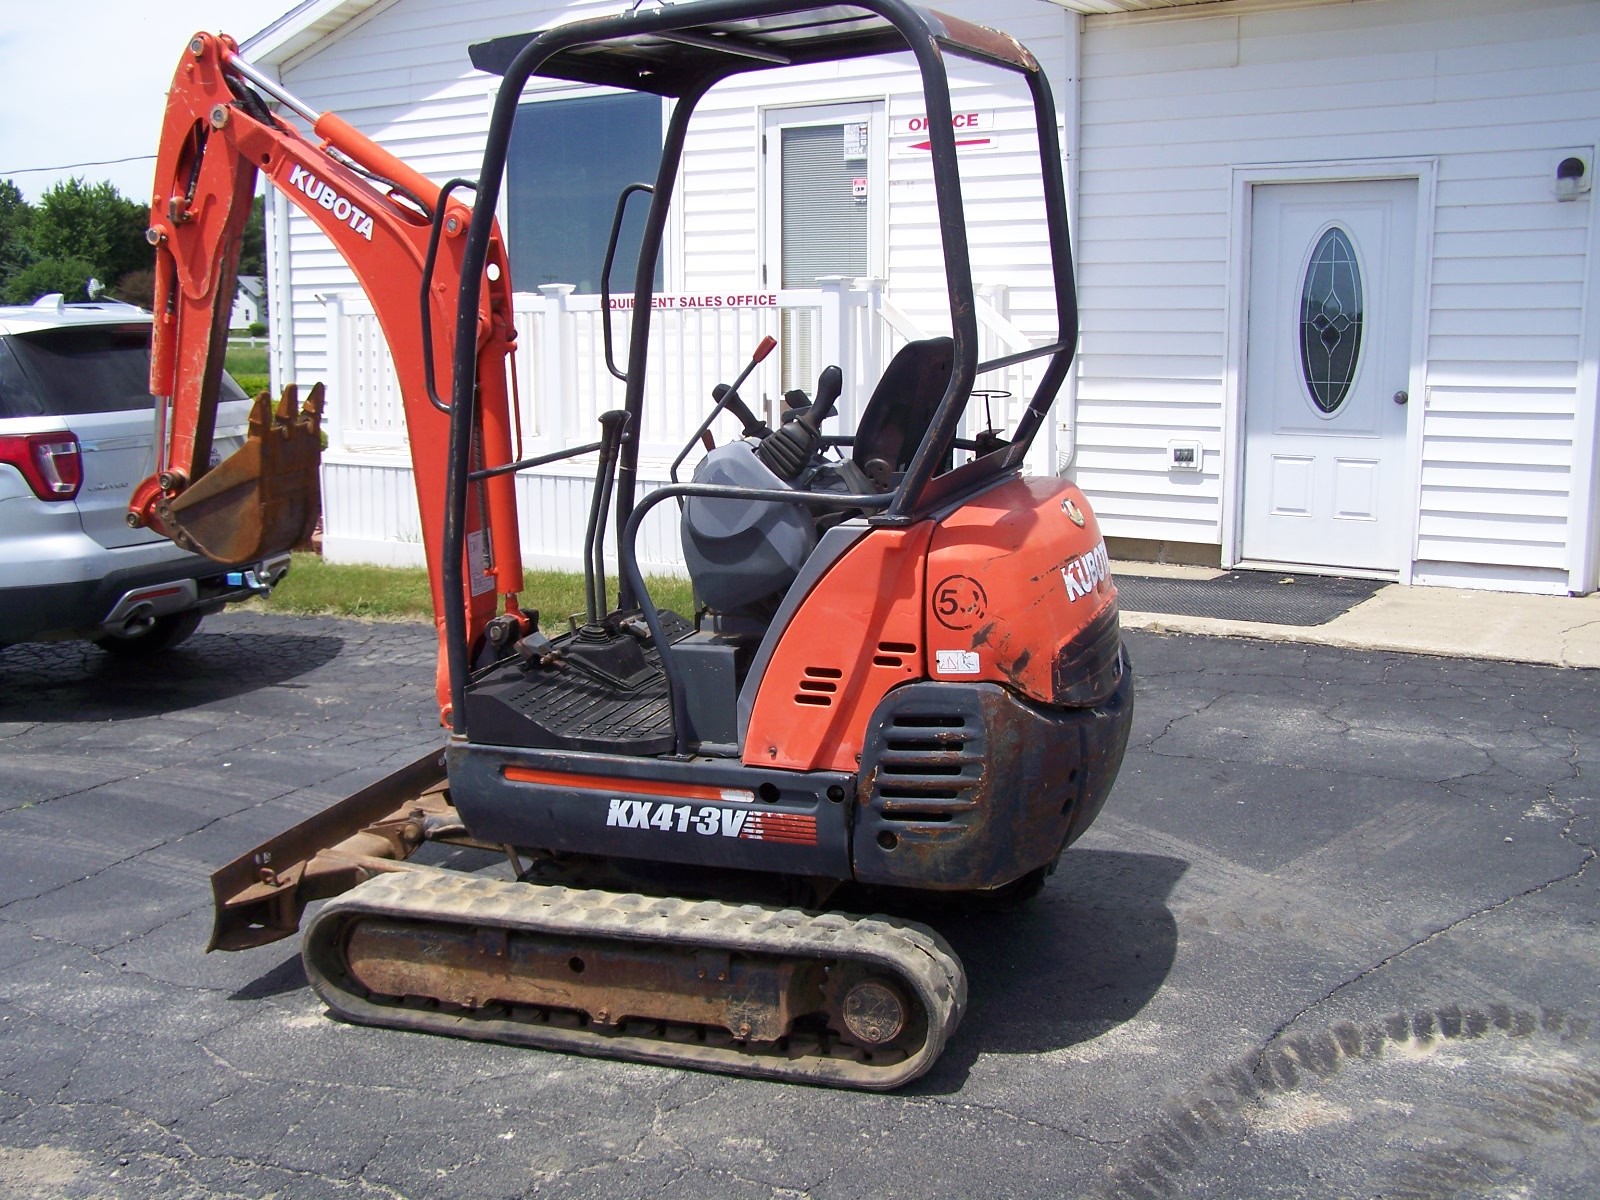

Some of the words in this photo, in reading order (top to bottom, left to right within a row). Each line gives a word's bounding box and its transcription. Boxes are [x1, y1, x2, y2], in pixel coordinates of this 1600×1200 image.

[908, 113, 979, 131] OFCE
[289, 164, 375, 242] KUBOTA
[600, 297, 675, 309] QUIPENT
[680, 296, 722, 307] SALES
[727, 295, 777, 306] OFFICE
[1060, 541, 1110, 603] KUBOT
[606, 799, 748, 838] KX41-3V
